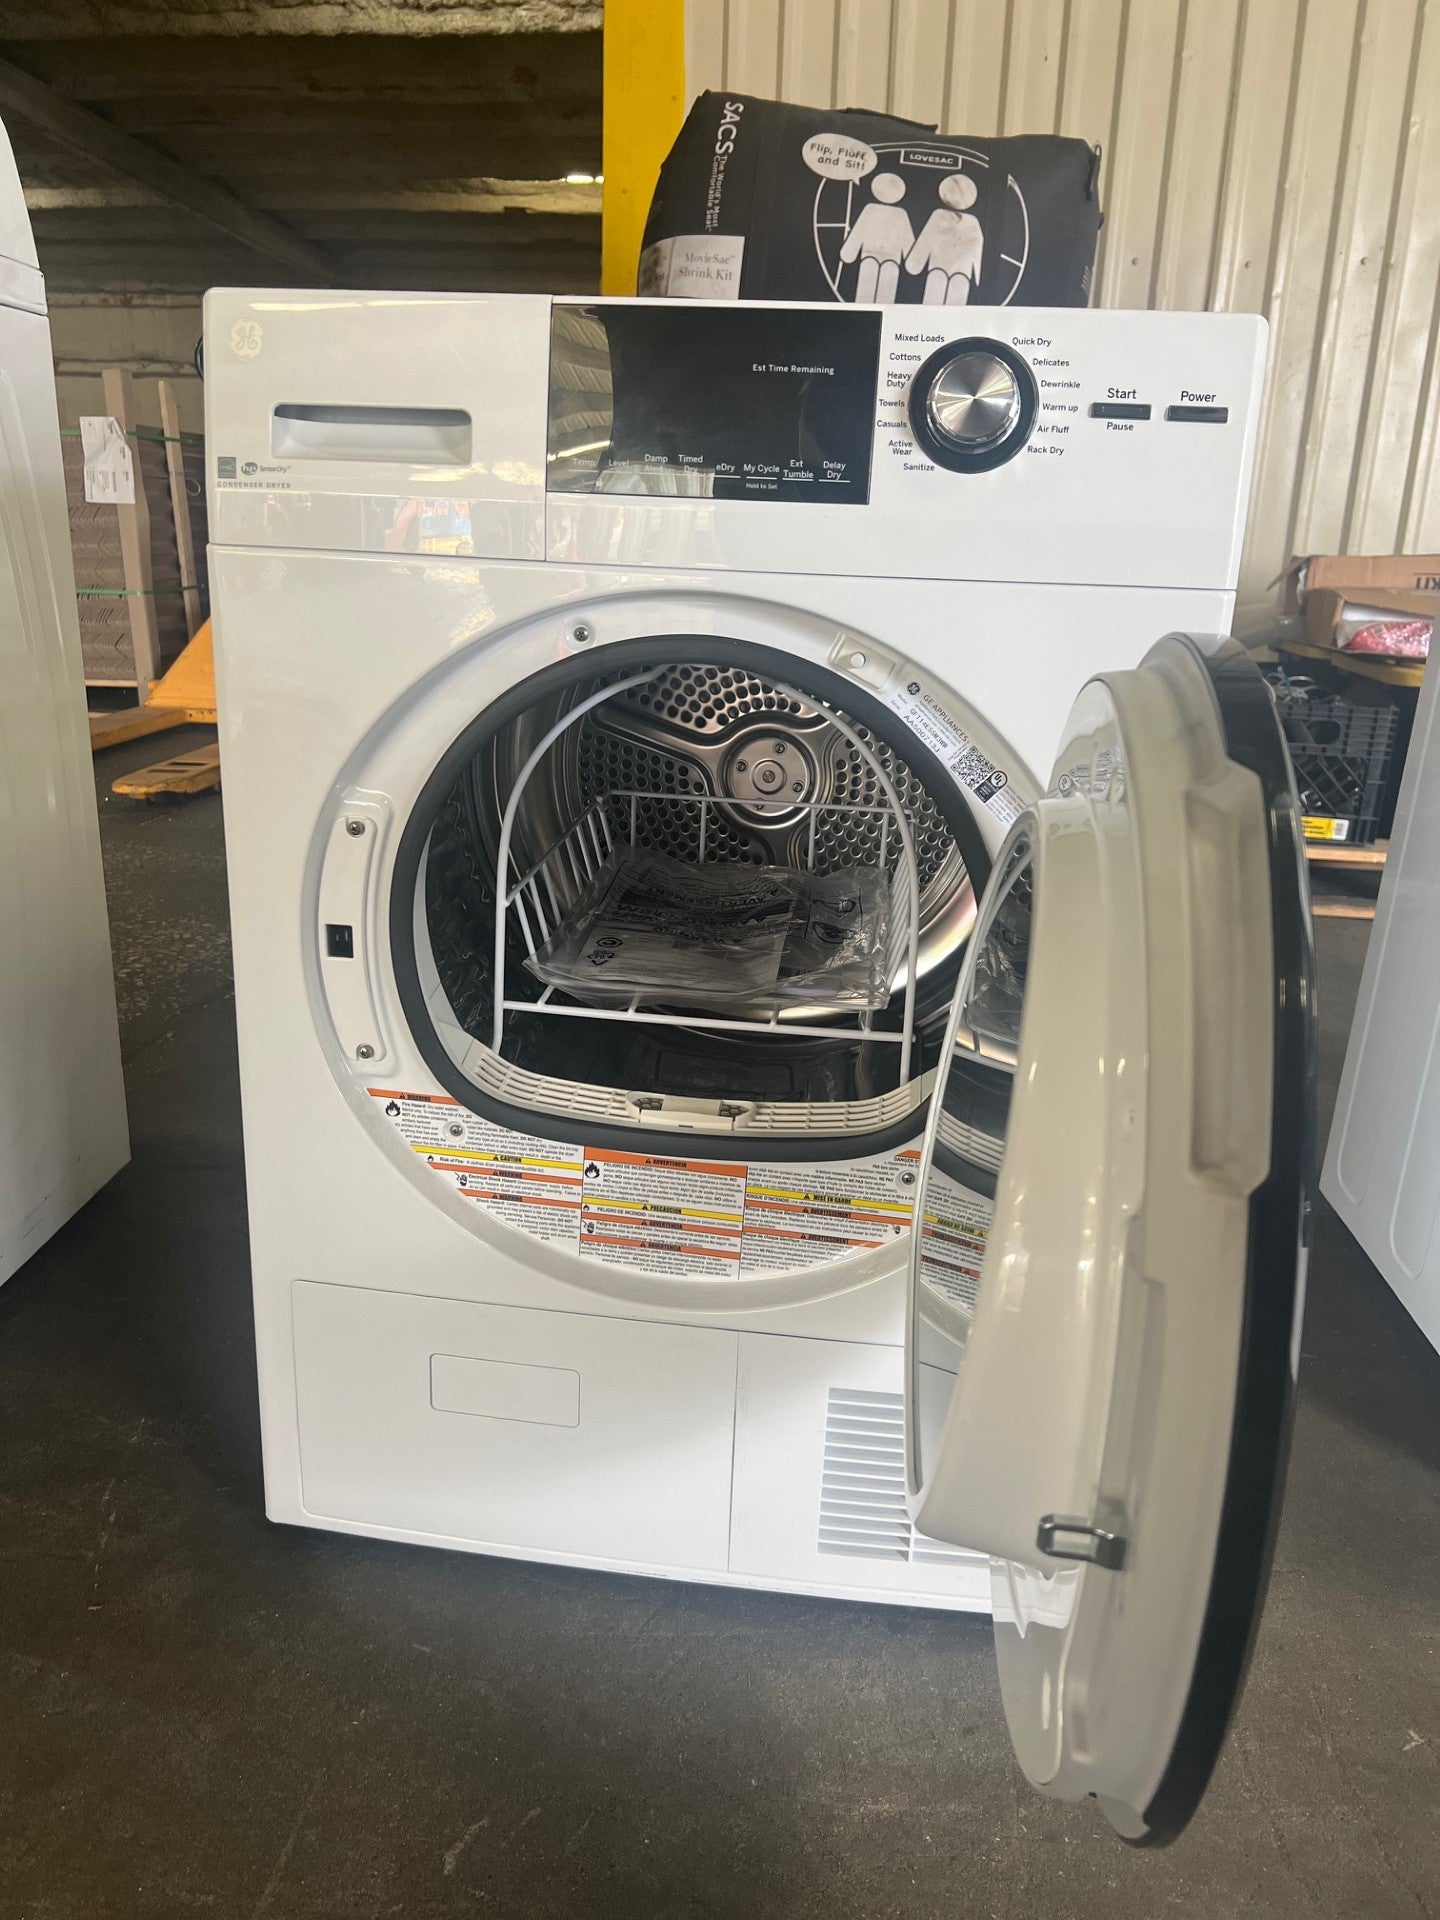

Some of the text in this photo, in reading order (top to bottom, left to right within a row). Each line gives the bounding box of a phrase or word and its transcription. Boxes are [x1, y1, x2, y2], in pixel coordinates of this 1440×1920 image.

[715, 101, 744, 154] SACS
[810, 142, 868, 161] Flip, Fluff
[718, 155, 728, 171] The
[817, 156, 866, 170] and Sit!
[909, 153, 954, 164] LOVESAC
[712, 205, 720, 227] Most
[678, 266, 732, 281] Shrink Kit
[894, 333, 945, 342] Mixed Loads
[1012, 337, 1052, 347] Quick Dry
[889, 352, 921, 361] Cottons
[1032, 358, 1070, 367] Delicates
[752, 363, 835, 376] Est Time Remaining
[887, 371, 912, 381] Heavy
[887, 380, 905, 389] Duty
[1040, 380, 1081, 389] Dewrinkle
[1107, 388, 1137, 400] Start
[1180, 390, 1216, 403] Power
[879, 399, 905, 407] Towels
[1042, 403, 1079, 413] Warm up
[876, 420, 907, 428] Casuals
[1106, 422, 1134, 431] Pause
[1037, 425, 1069, 434] Air Fluff
[892, 448, 912, 456] Wear
[1027, 446, 1064, 456] Rack Dry
[574, 457, 595, 467] Temp
[608, 459, 630, 467] Level
[644, 453, 668, 463] Damp
[678, 454, 703, 463] Timed
[716, 463, 735, 472] eDry
[790, 459, 803, 468] Ext
[823, 460, 846, 471] Delay
[903, 462, 935, 471] Sanitize
[684, 466, 698, 474] Dry
[743, 464, 780, 474] My Cycle
[783, 469, 814, 478] Tumble
[827, 470, 841, 480] Dry
[933, 705, 969, 742] APPLIANCES
[994, 773, 1002, 785] UL
